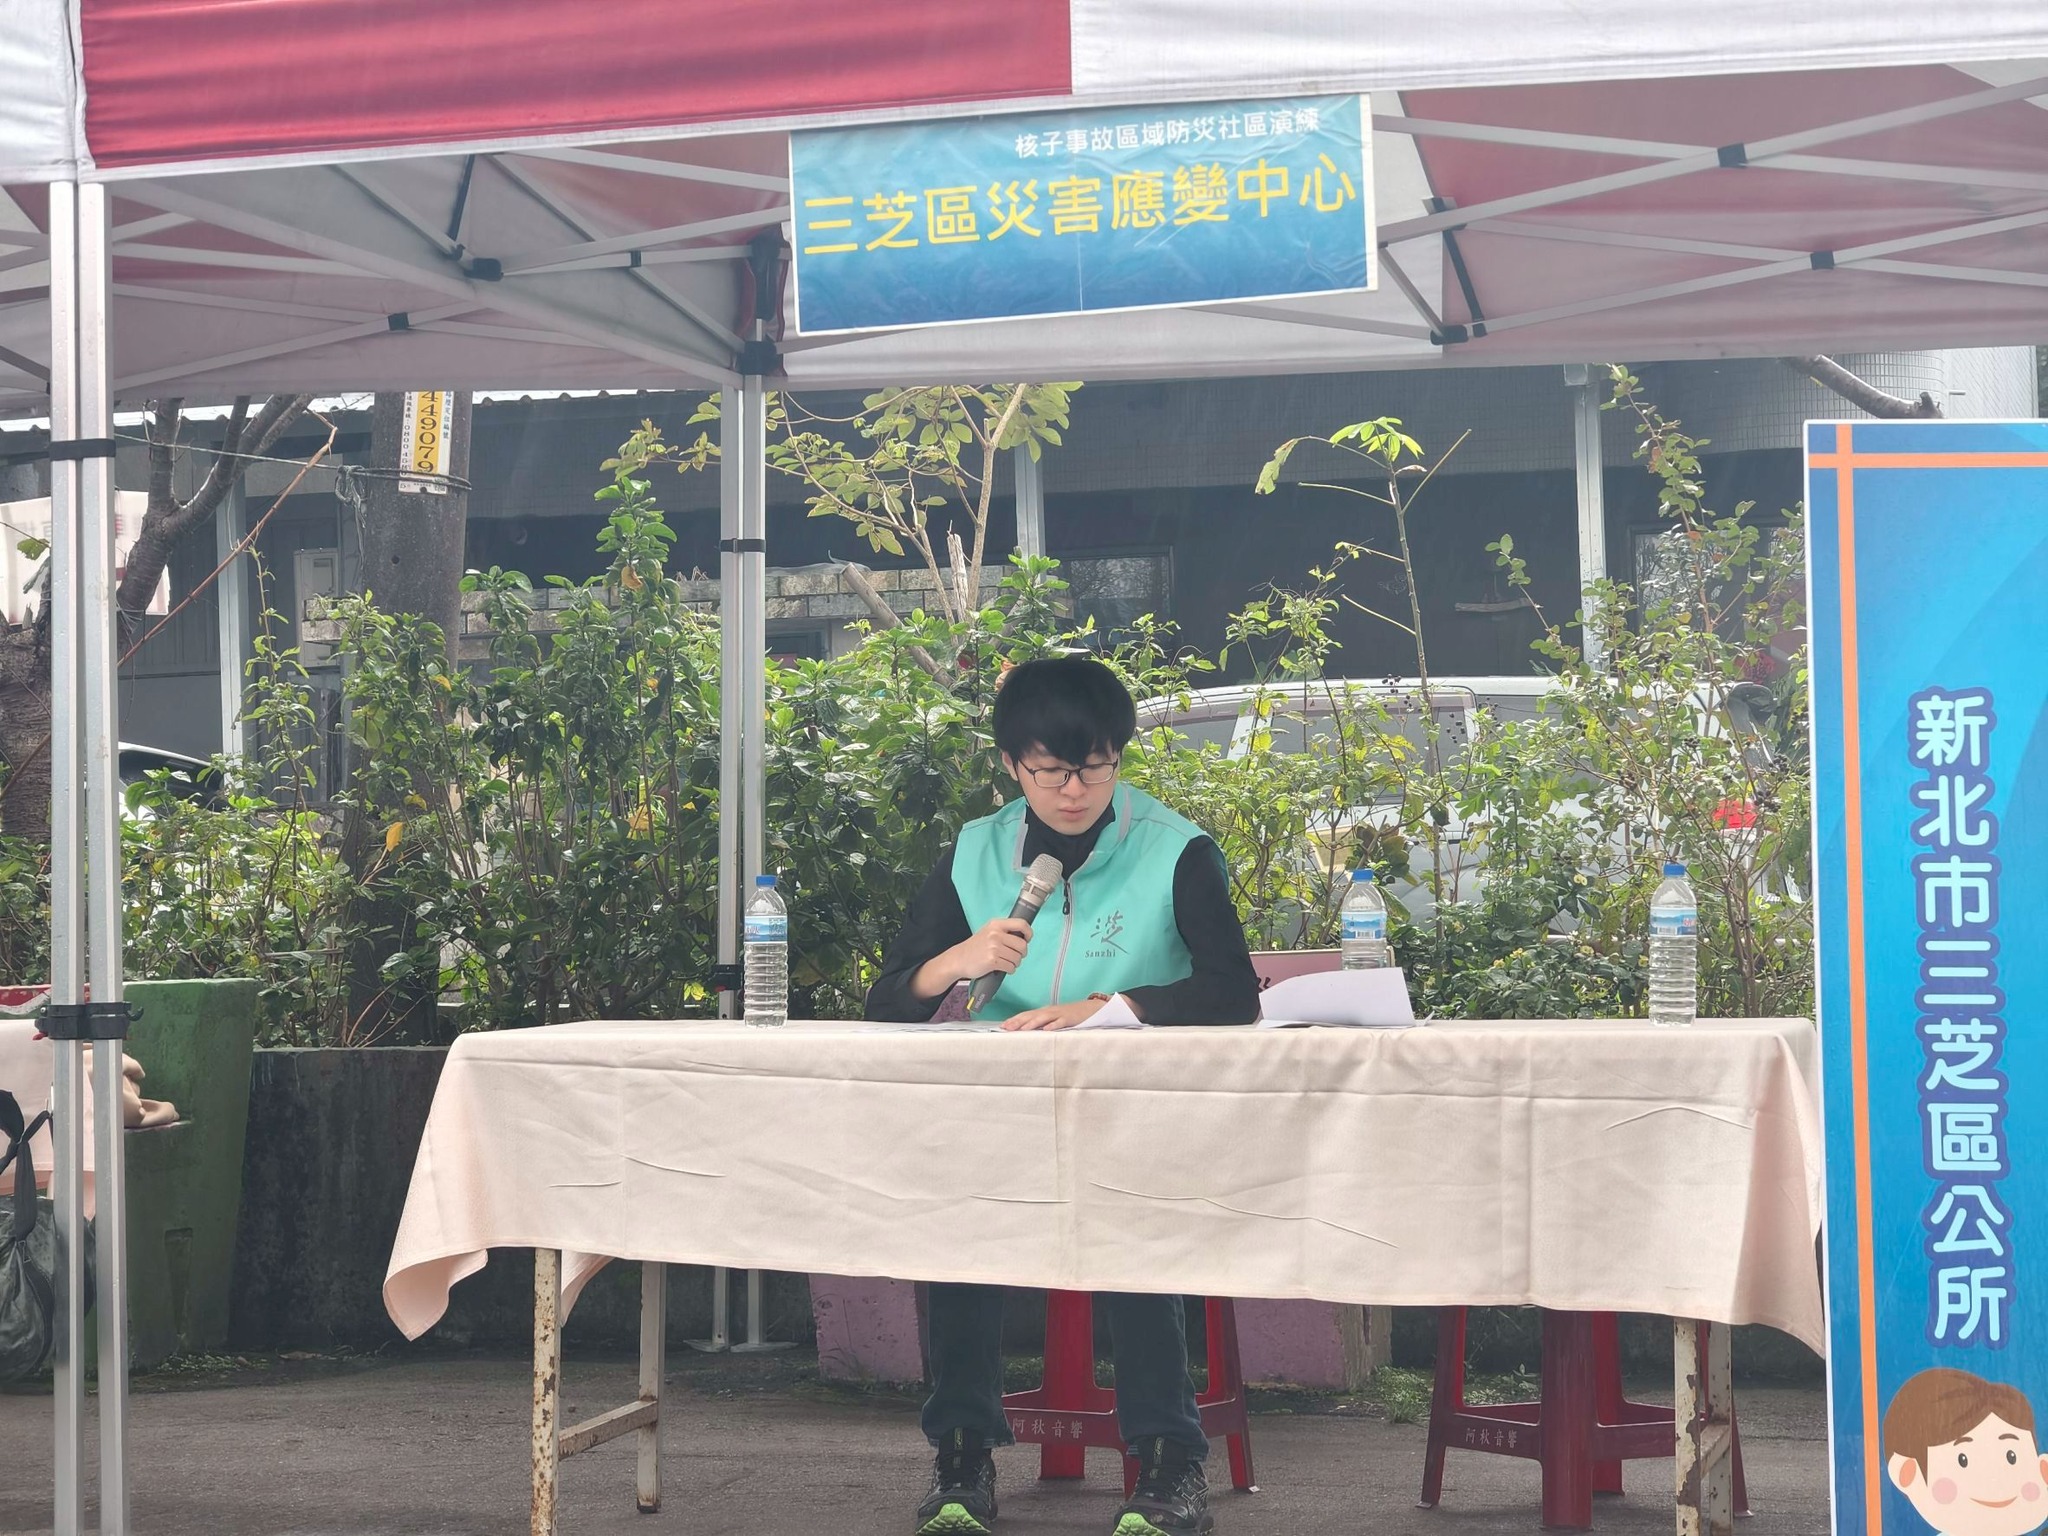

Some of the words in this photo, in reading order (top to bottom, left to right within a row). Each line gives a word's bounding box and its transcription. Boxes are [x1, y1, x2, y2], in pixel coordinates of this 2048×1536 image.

[1015, 107, 1321, 158] 核子事故區域防災社區演練
[803, 152, 1357, 256] 三芝區災害應變中心
[1084, 948, 1116, 958] Sanzhi
[1915, 694, 2008, 1342] 新北市三芝區公所
[1011, 1417, 1084, 1440] 阿秋音響
[1464, 1427, 1519, 1449] 阿秋音響
